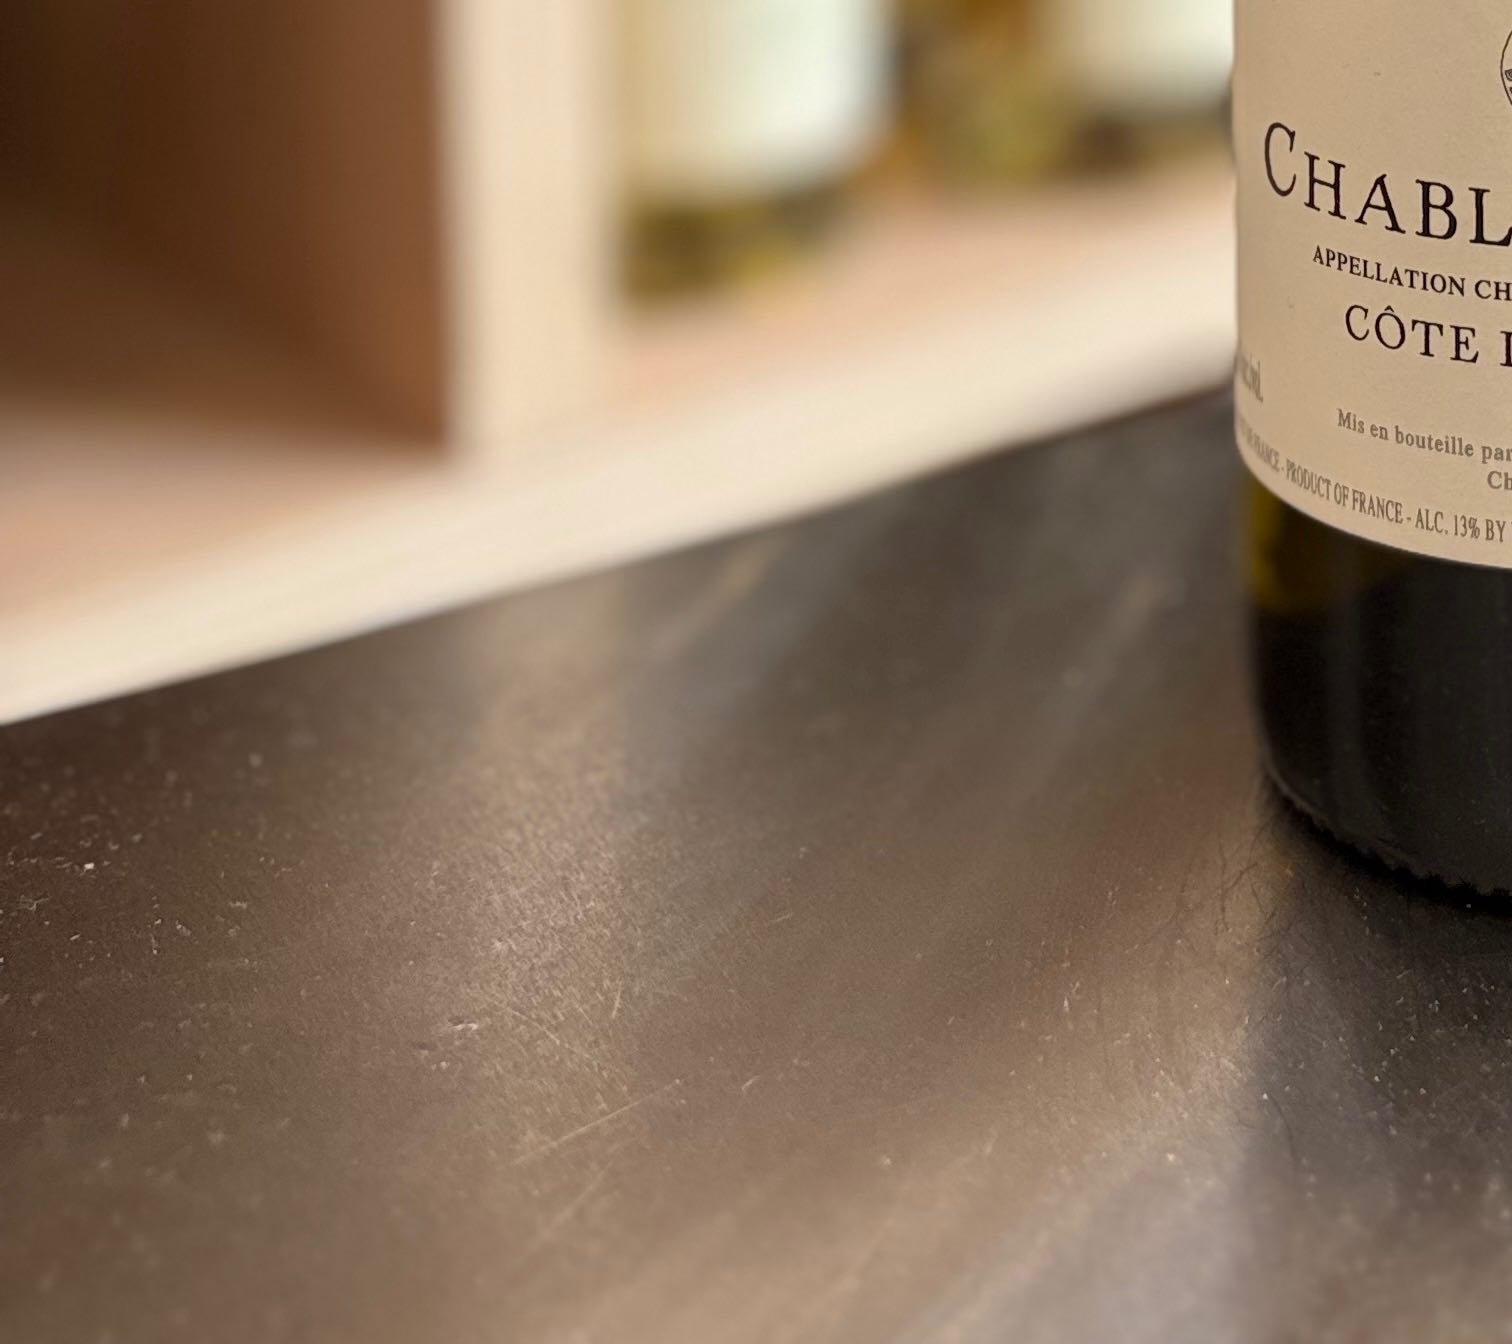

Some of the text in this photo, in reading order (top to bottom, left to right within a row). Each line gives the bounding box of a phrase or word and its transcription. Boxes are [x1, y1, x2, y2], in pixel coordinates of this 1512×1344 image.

[1312, 244, 1466, 298] APPELLATION
[1344, 303, 1480, 365] CÔTE
[1337, 408, 1366, 435] Mis
[1369, 421, 1389, 442] en
[1395, 424, 1475, 458] bouteille
[1286, 458, 1332, 501] PRODUCT
[1334, 481, 1350, 508] OF
[1352, 488, 1403, 525] FRANCE
[1415, 507, 1449, 536] ALC.
[1454, 514, 1481, 540] 13%
[1485, 518, 1507, 543] BY
